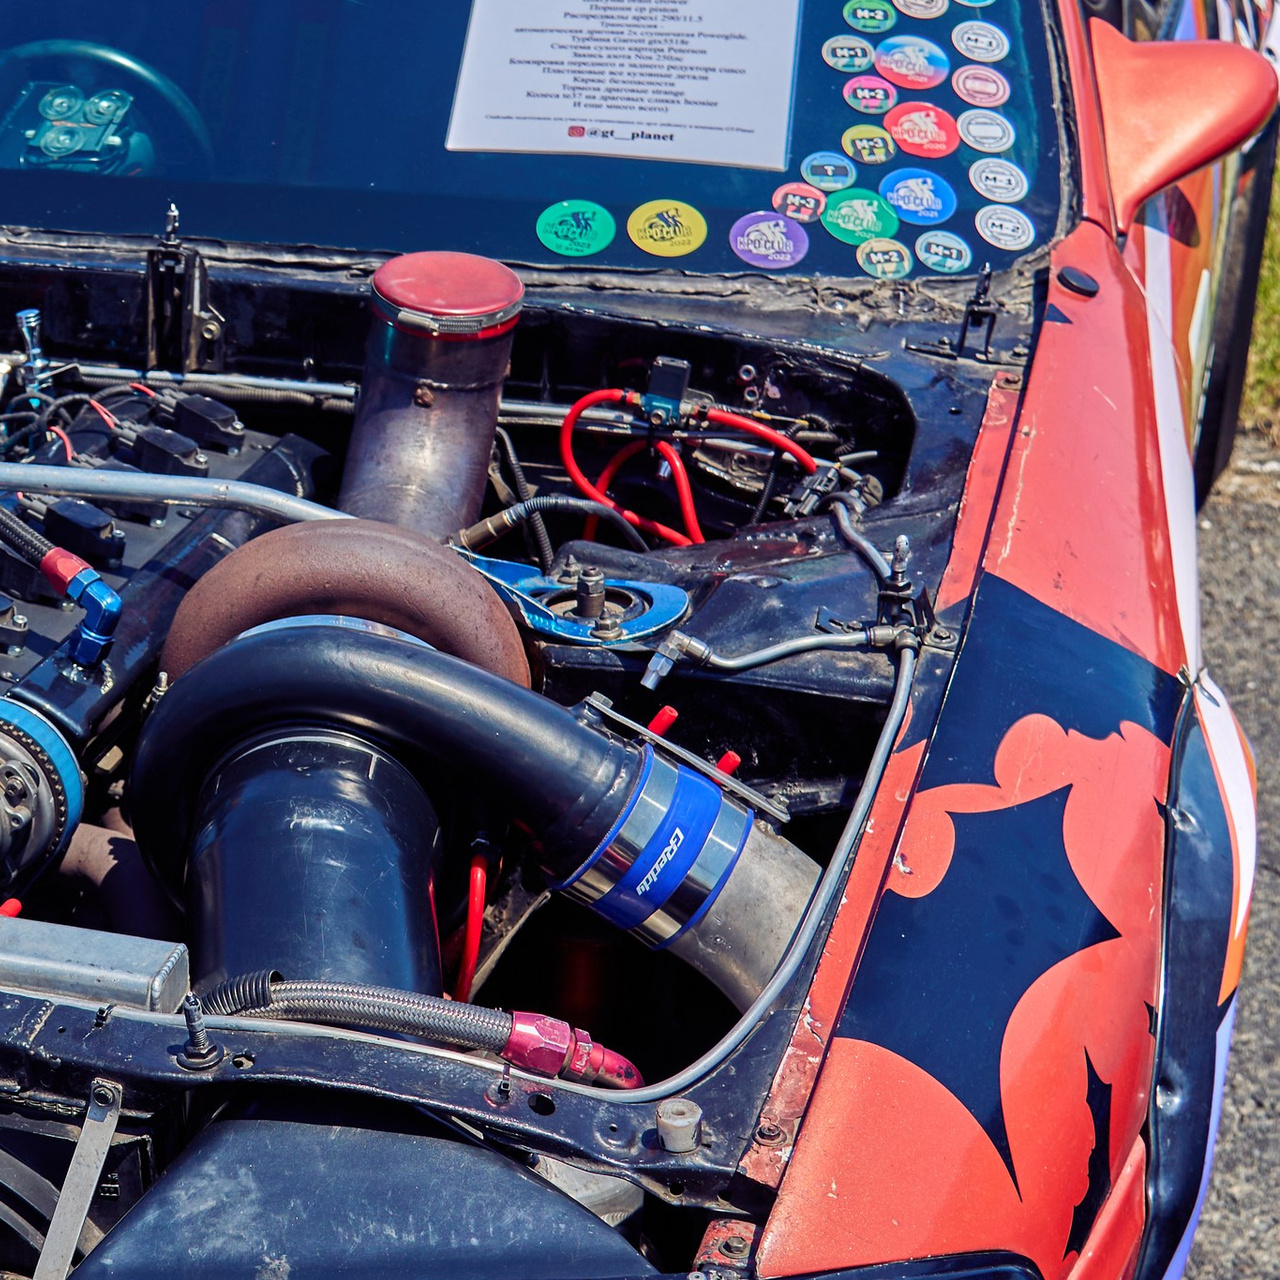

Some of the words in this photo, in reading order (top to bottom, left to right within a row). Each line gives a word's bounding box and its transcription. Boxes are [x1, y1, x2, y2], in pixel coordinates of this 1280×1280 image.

[856, 8, 885, 19] M-2
[836, 48, 863, 58] M-1
[667, 65, 715, 73] редуктора
[562, 84, 600, 92] Тормоза
[856, 88, 885, 100] M-2
[855, 138, 884, 149] M-3
[787, 194, 816, 208] M-3
[991, 222, 1019, 233] M-2
[764, 240, 794, 252] CLUB
[930, 244, 959, 259] M-1
[870, 251, 900, 263] M-2
[636, 827, 684, 896] GReddy
